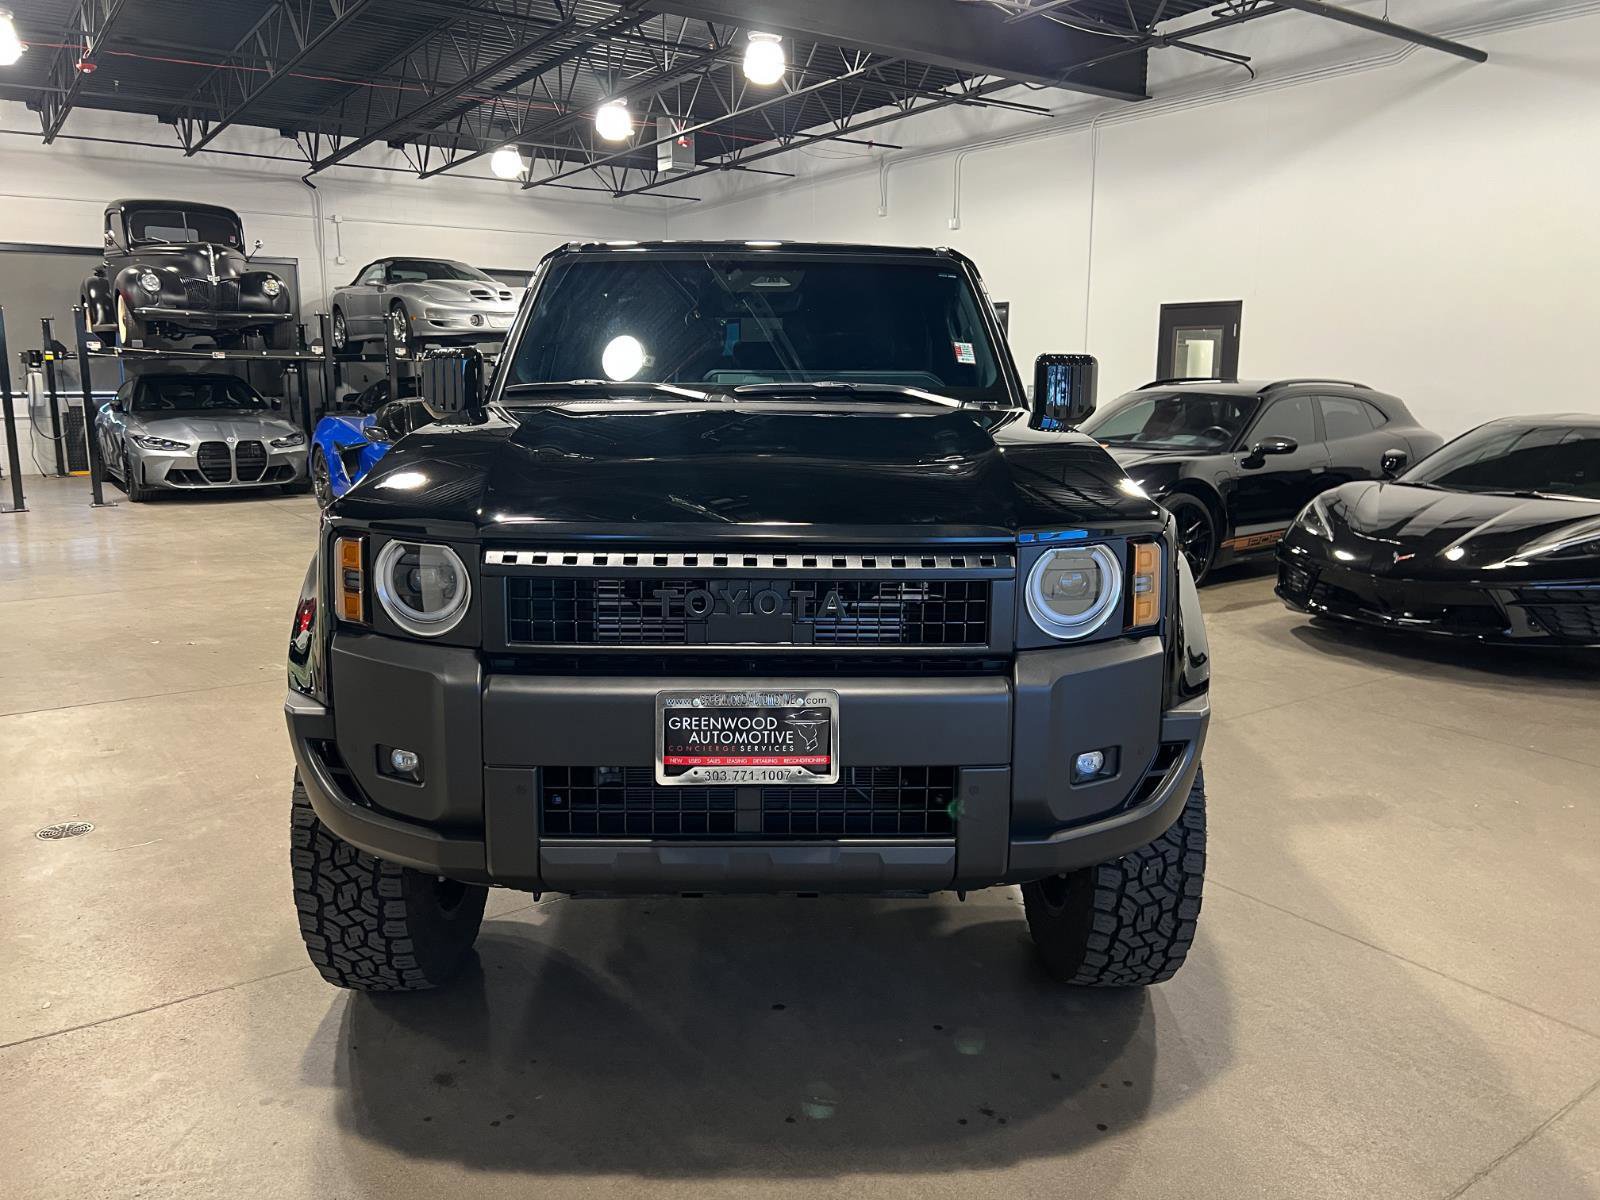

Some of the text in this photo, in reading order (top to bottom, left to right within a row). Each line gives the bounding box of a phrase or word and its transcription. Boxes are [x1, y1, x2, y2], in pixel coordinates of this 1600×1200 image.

[653, 589, 848, 618] TOYOTA
[668, 717, 778, 730] GREENWOOD
[688, 731, 794, 744] AUTOMOTIVE
[704, 770, 791, 781] 303.771.1007
